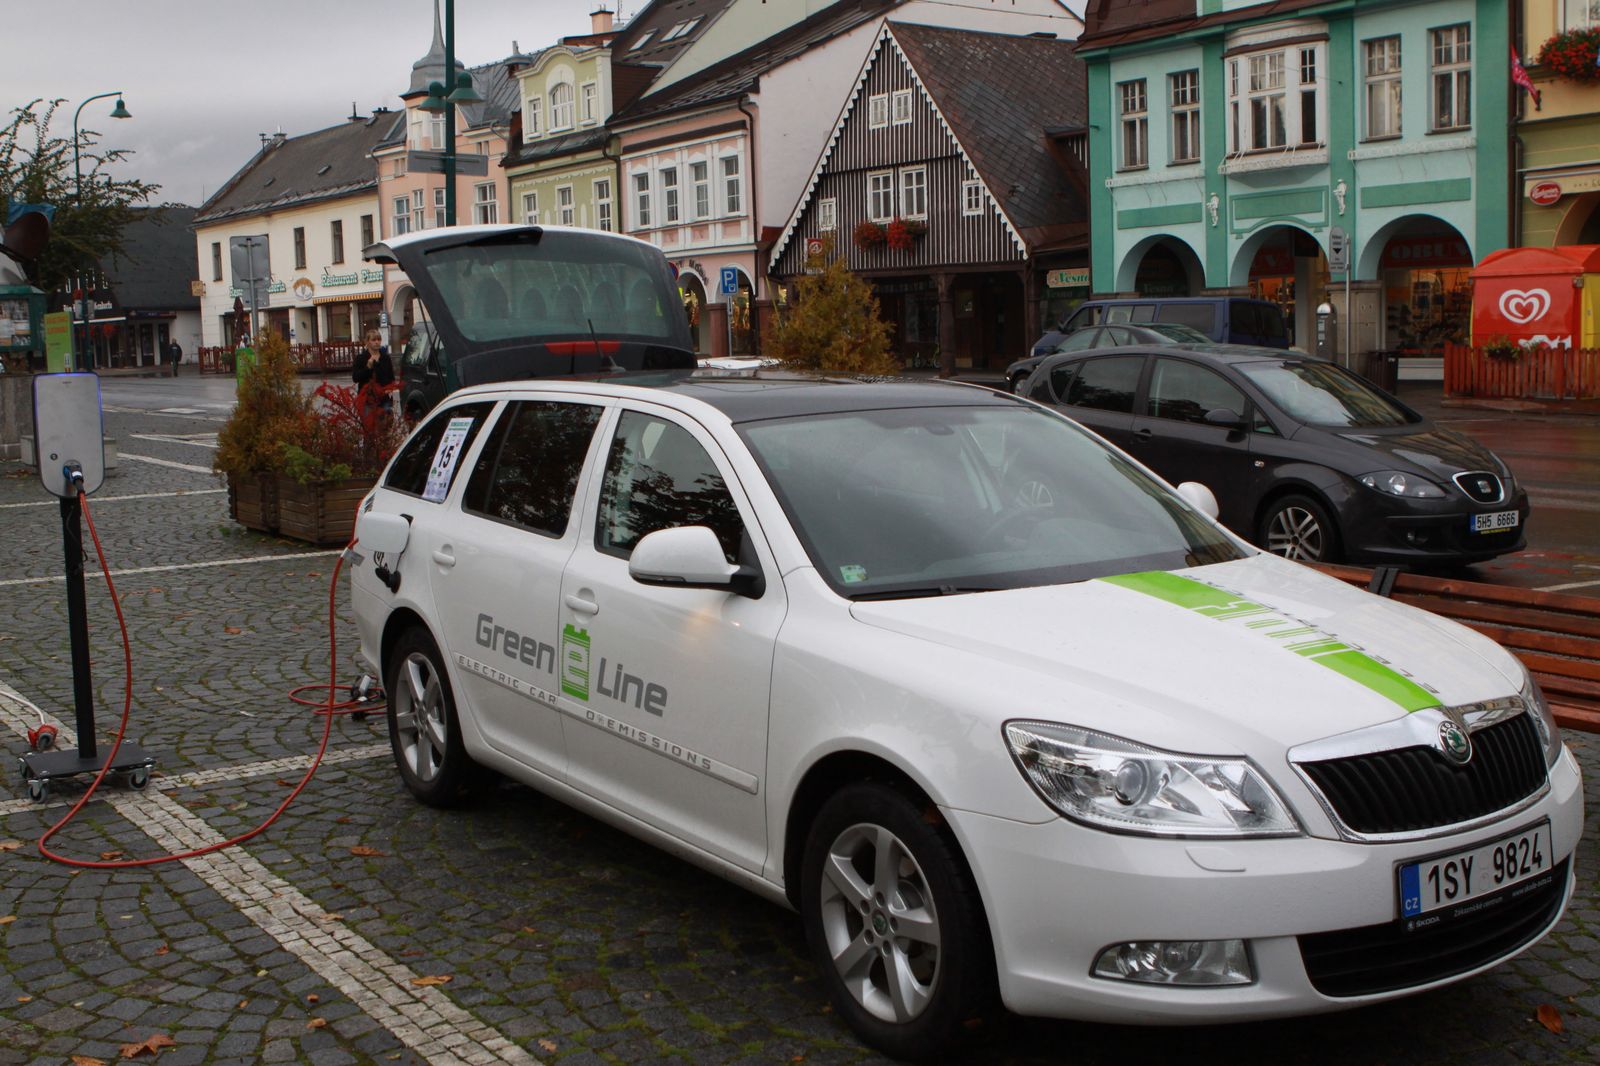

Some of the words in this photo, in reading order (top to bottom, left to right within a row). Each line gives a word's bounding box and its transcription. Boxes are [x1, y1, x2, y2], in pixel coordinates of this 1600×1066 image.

[320, 272, 359, 286] Restaurant
[724, 271, 733, 286] P
[438, 445, 455, 468] 15
[1477, 515, 1492, 528] 5H5
[1497, 512, 1516, 526] 6666
[476, 613, 555, 674] Green
[597, 657, 667, 718] Line
[459, 656, 519, 689] ELECTRIC
[529, 687, 556, 705] CAR
[1428, 855, 1473, 904] 1SY
[1493, 833, 1542, 884] 9824
[1405, 897, 1419, 911] CZ
